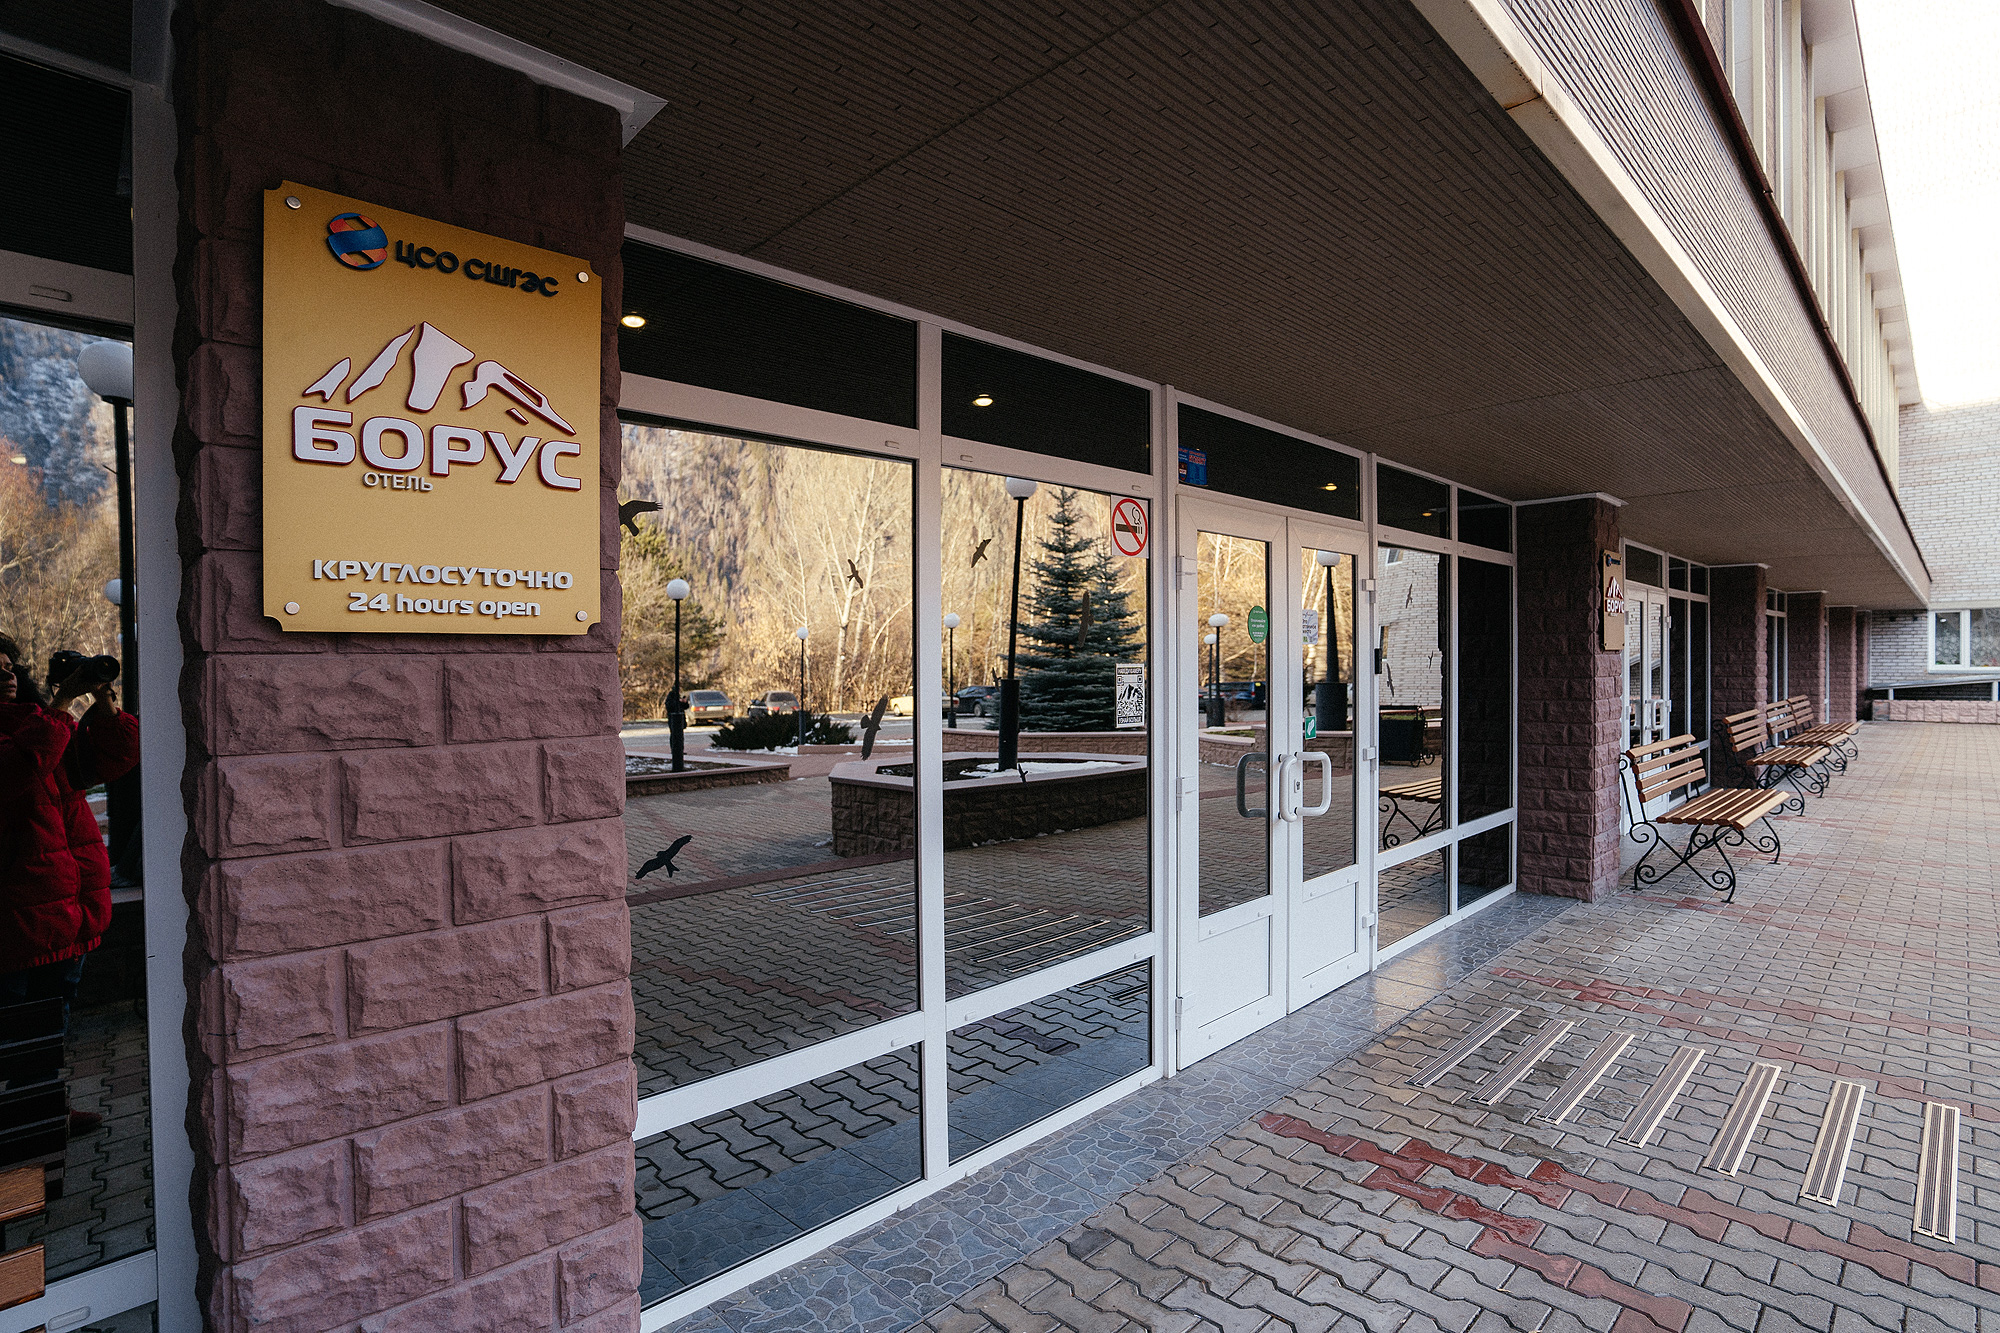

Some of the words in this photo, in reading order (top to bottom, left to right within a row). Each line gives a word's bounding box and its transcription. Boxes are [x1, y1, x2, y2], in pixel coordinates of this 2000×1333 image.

[396, 239, 460, 274] ЦСО
[463, 258, 560, 298] СШГЭС
[292, 405, 582, 491] БОРУС
[362, 472, 434, 492] ОТЕЛЬ
[312, 559, 574, 590] КРУГЛОСУТОЧНО
[347, 592, 391, 613] 24
[395, 593, 474, 614] hours
[478, 600, 541, 619] open
